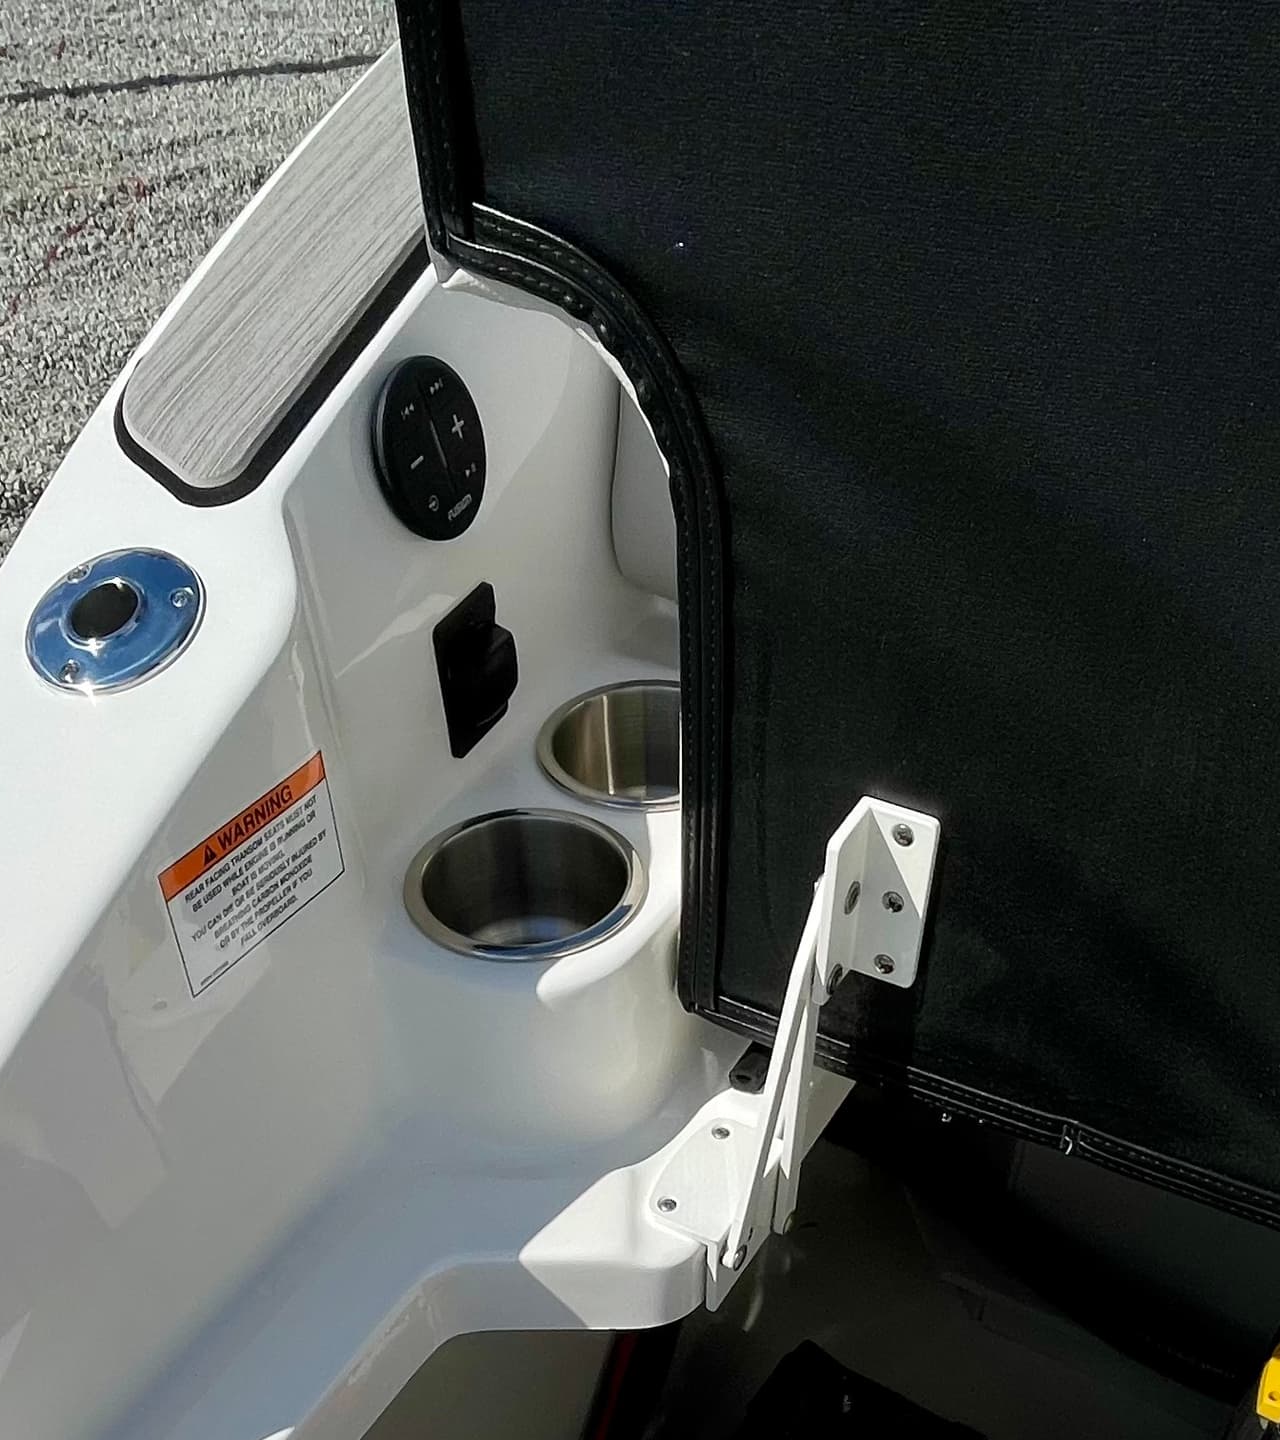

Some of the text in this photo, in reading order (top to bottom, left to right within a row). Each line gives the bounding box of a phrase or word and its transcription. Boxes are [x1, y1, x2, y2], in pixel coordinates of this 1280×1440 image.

[183, 881, 205, 905] REAR
[203, 860, 231, 889] FACING
[230, 835, 263, 868] TRANSOM
[262, 818, 285, 843] SEATS
[302, 792, 317, 812] NOT
[217, 781, 293, 855] WARNING
[190, 924, 207, 944] YOU
[206, 911, 223, 931] CAN
[234, 893, 246, 909] OR
[290, 835, 317, 864] INJURED
[317, 827, 327, 842] BY
[191, 898, 203, 914] BE
[202, 882, 223, 905] USED
[221, 865, 244, 890] WHILE
[305, 808, 316, 823] OR
[231, 875, 250, 897] BOAT
[249, 869, 258, 883] IS
[251, 880, 280, 910] CARBON
[218, 933, 231, 950] OR
[230, 925, 241, 941] BY
[240, 914, 254, 933] THE
[254, 883, 292, 921] PROPELLER
[298, 866, 313, 885] YOU
